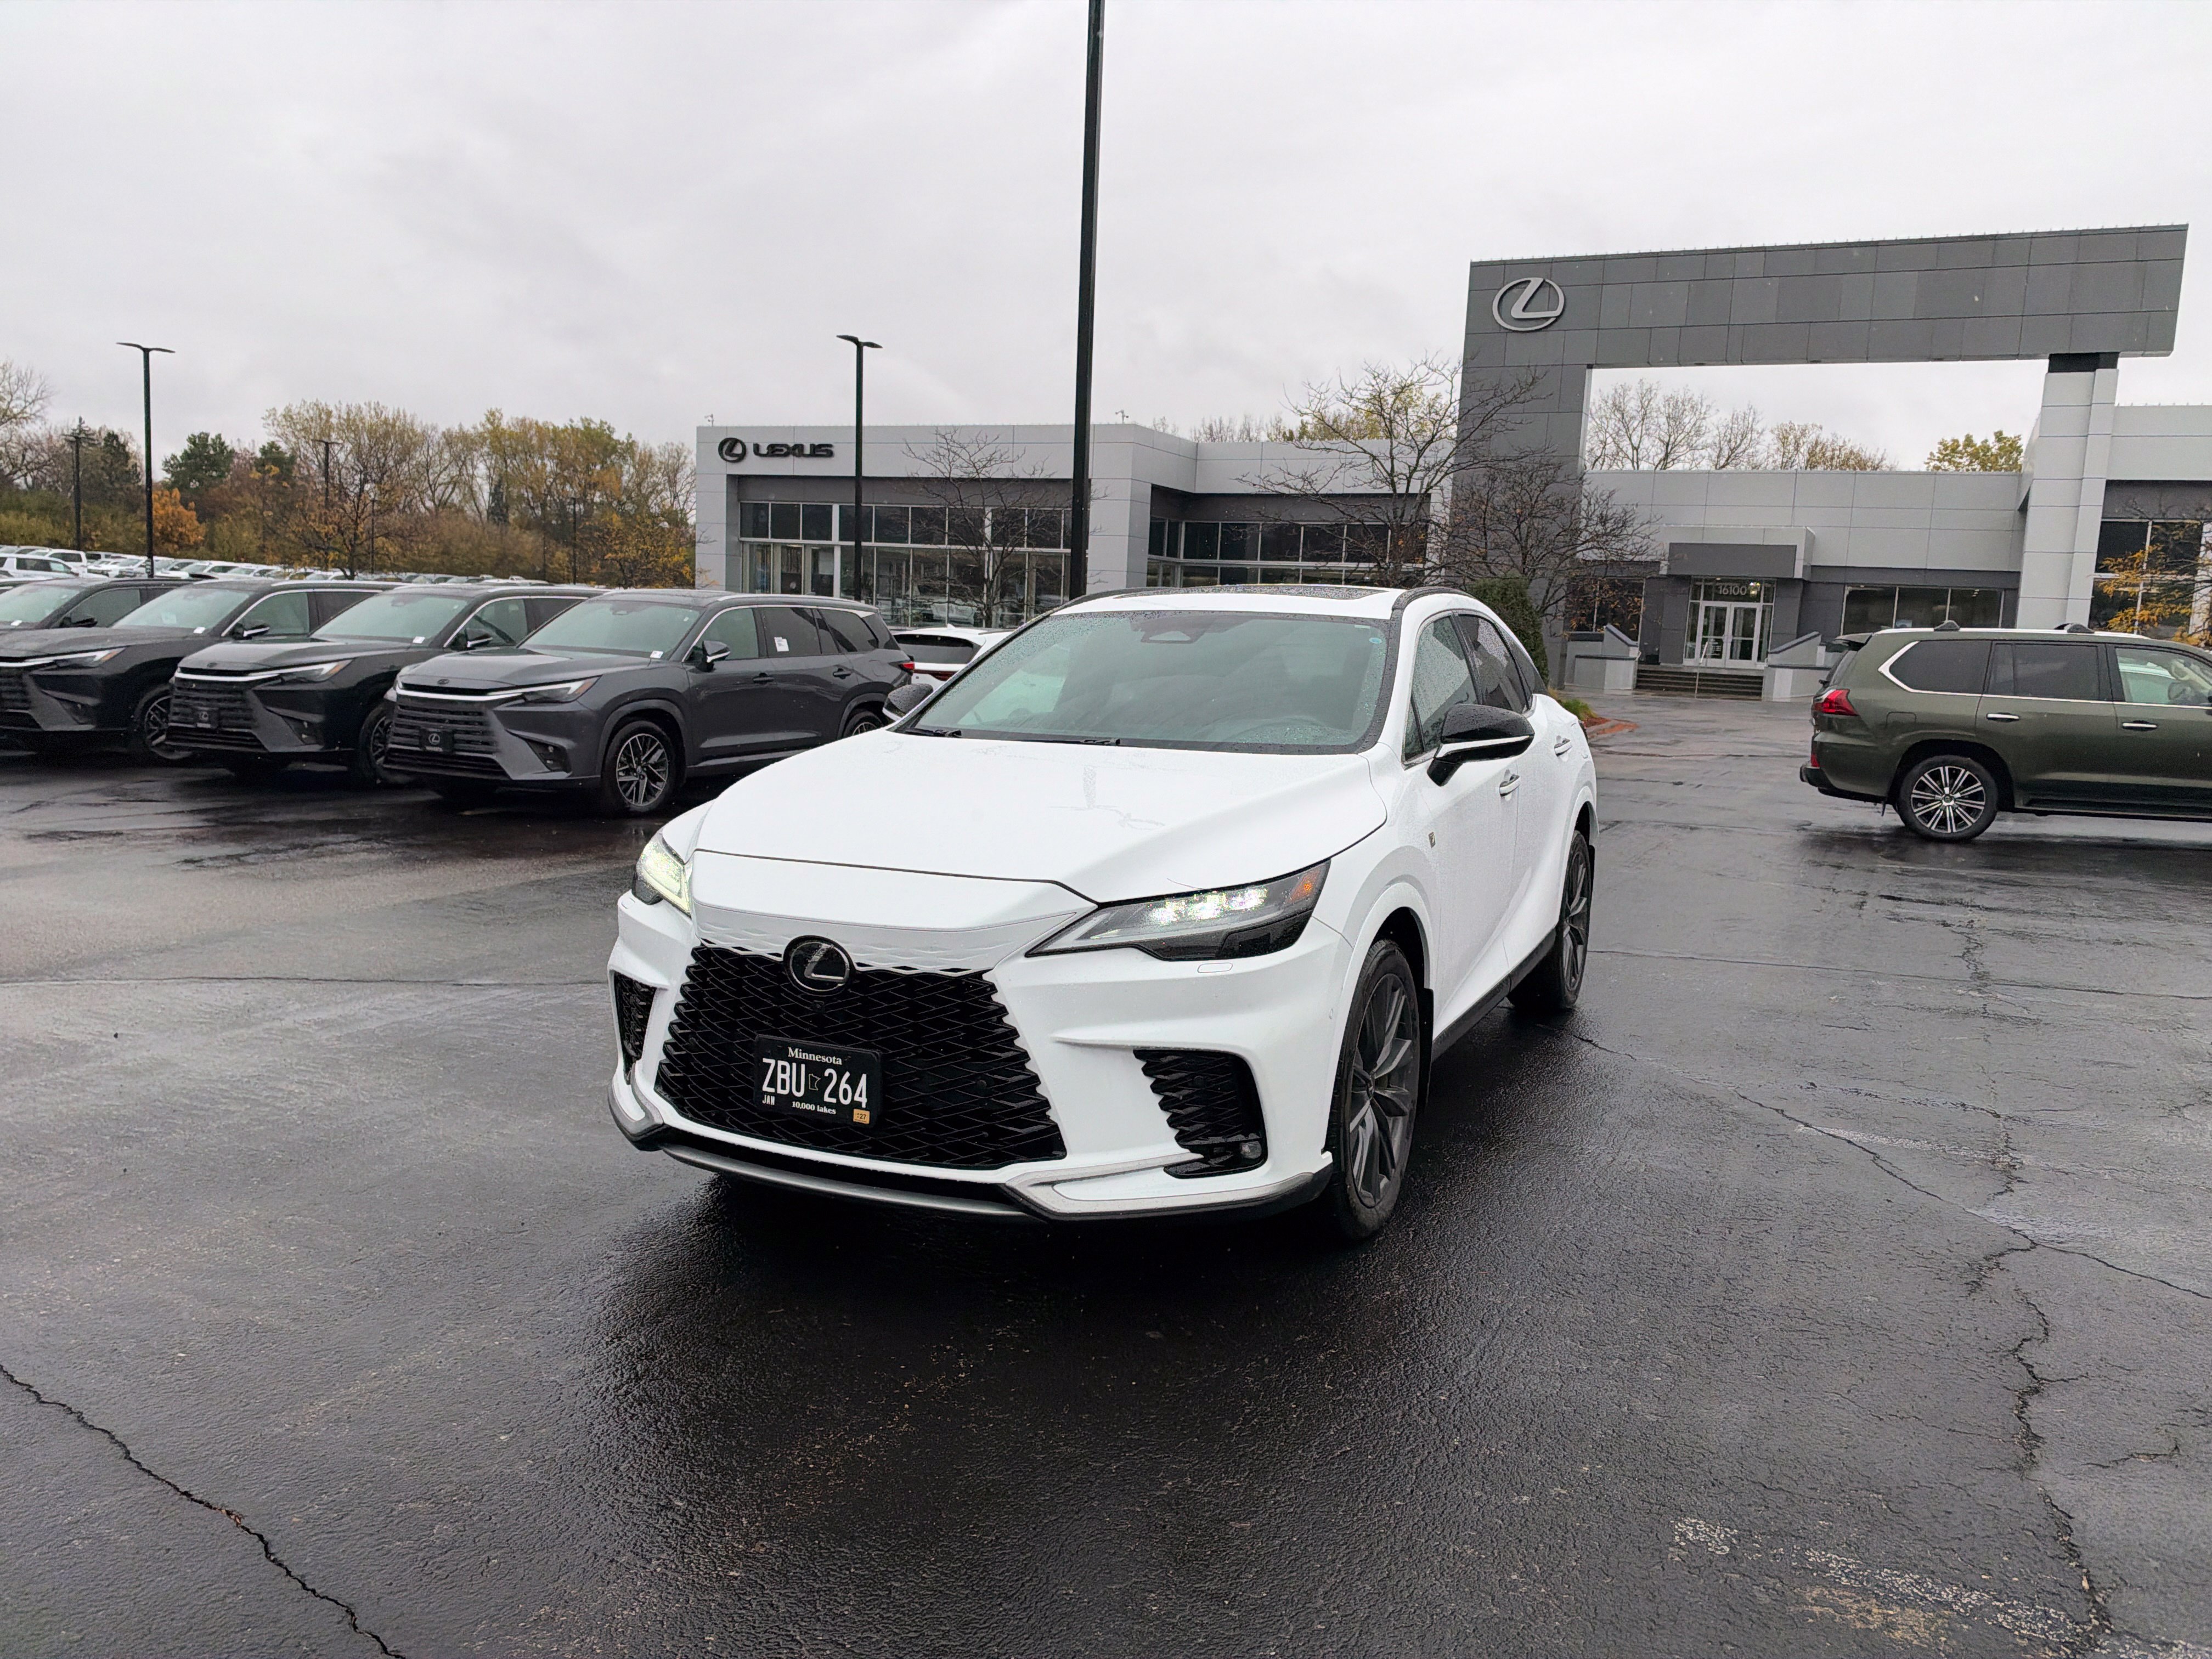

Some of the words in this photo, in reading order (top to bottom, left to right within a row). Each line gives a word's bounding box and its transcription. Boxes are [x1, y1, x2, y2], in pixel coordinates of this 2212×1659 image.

[753, 443, 834, 458] LEXUS
[1718, 585, 1747, 595] 16100
[788, 1047, 842, 1065] Minnesota
[762, 1058, 805, 1097] ZBU
[823, 1068, 867, 1108] 264
[762, 1094, 775, 1105] JAN
[792, 1101, 815, 1110] 10,000
[817, 1104, 836, 1115] lakes
